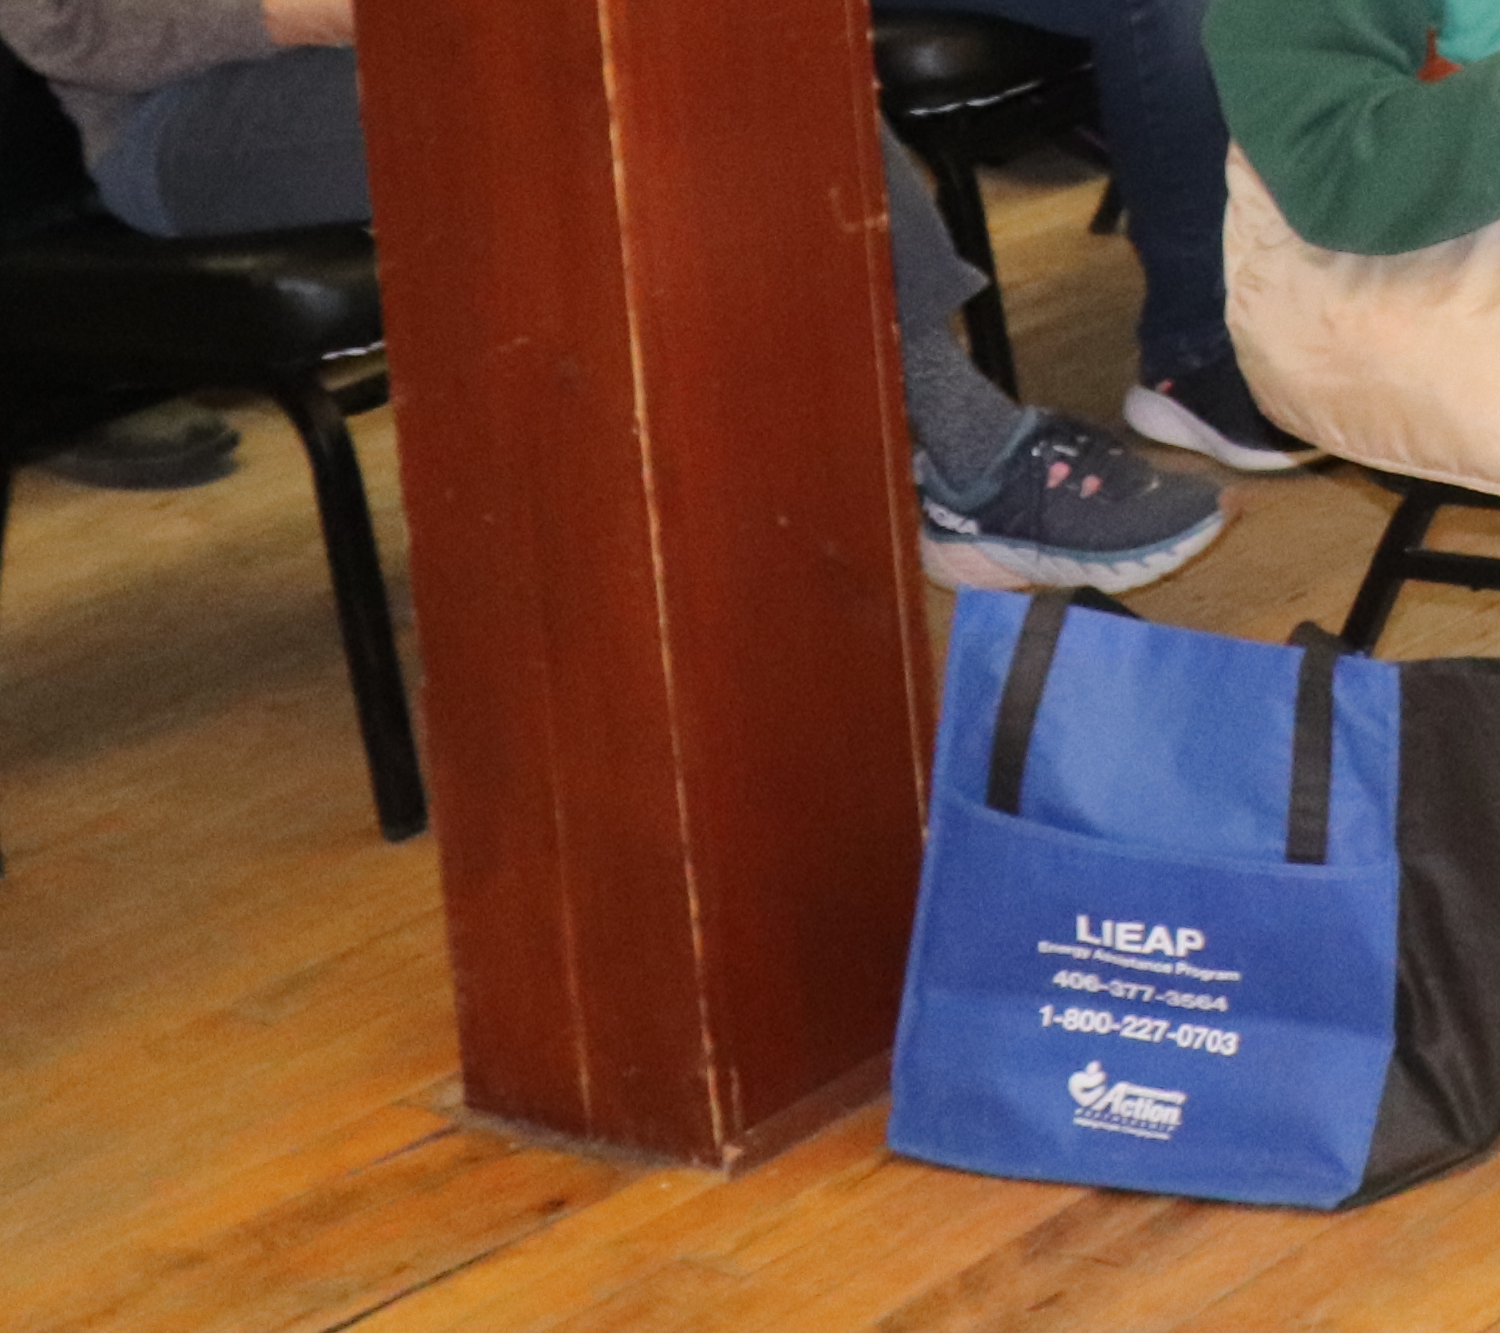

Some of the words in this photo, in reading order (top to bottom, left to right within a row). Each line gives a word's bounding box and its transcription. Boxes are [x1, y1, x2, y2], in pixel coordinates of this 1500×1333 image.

[1075, 914, 1206, 958] LIEAP
[1052, 969, 1230, 1013] 406-377-3564
[1174, 960, 1242, 982] Program
[1038, 1003, 1240, 1057] 1-800-227-0703
[1091, 1080, 1183, 1127] Action
